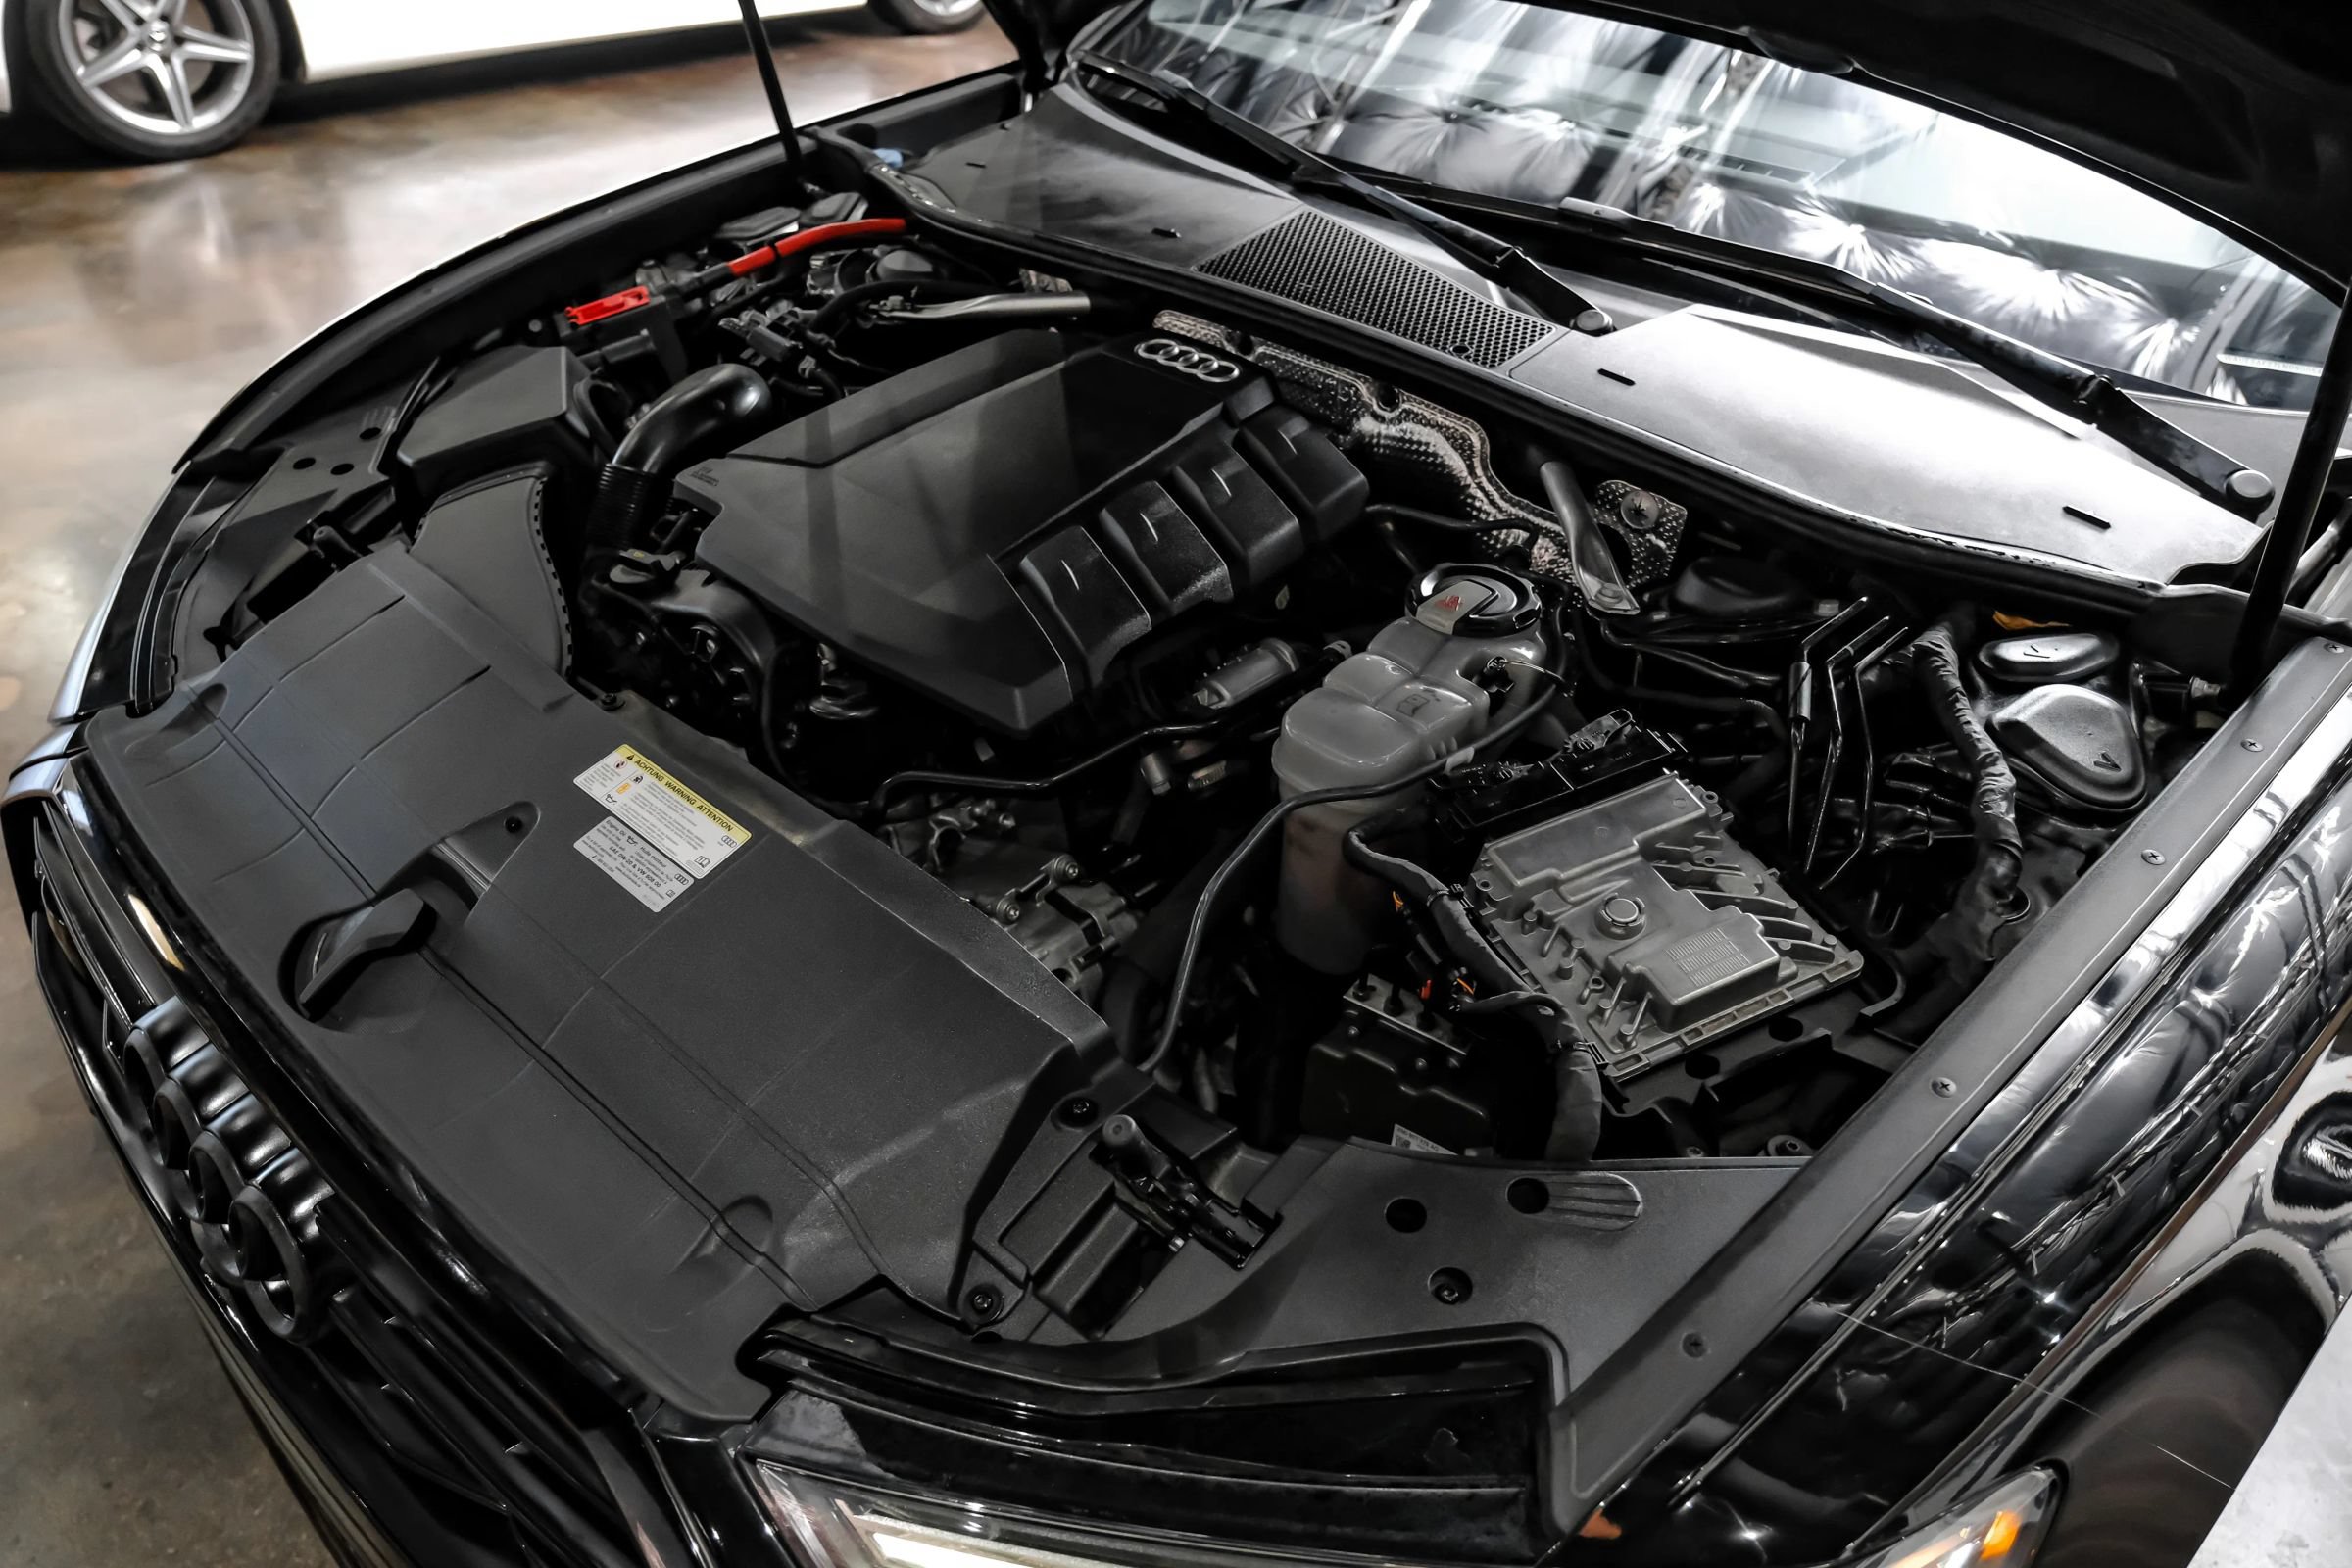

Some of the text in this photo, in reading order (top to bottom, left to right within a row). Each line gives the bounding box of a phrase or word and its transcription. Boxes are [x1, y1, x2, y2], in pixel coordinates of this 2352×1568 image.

[634, 760, 664, 782] ACHTUNG
[663, 781, 697, 805] WARNING
[696, 804, 734, 832] ATTENTION
[637, 867, 647, 876] VW
